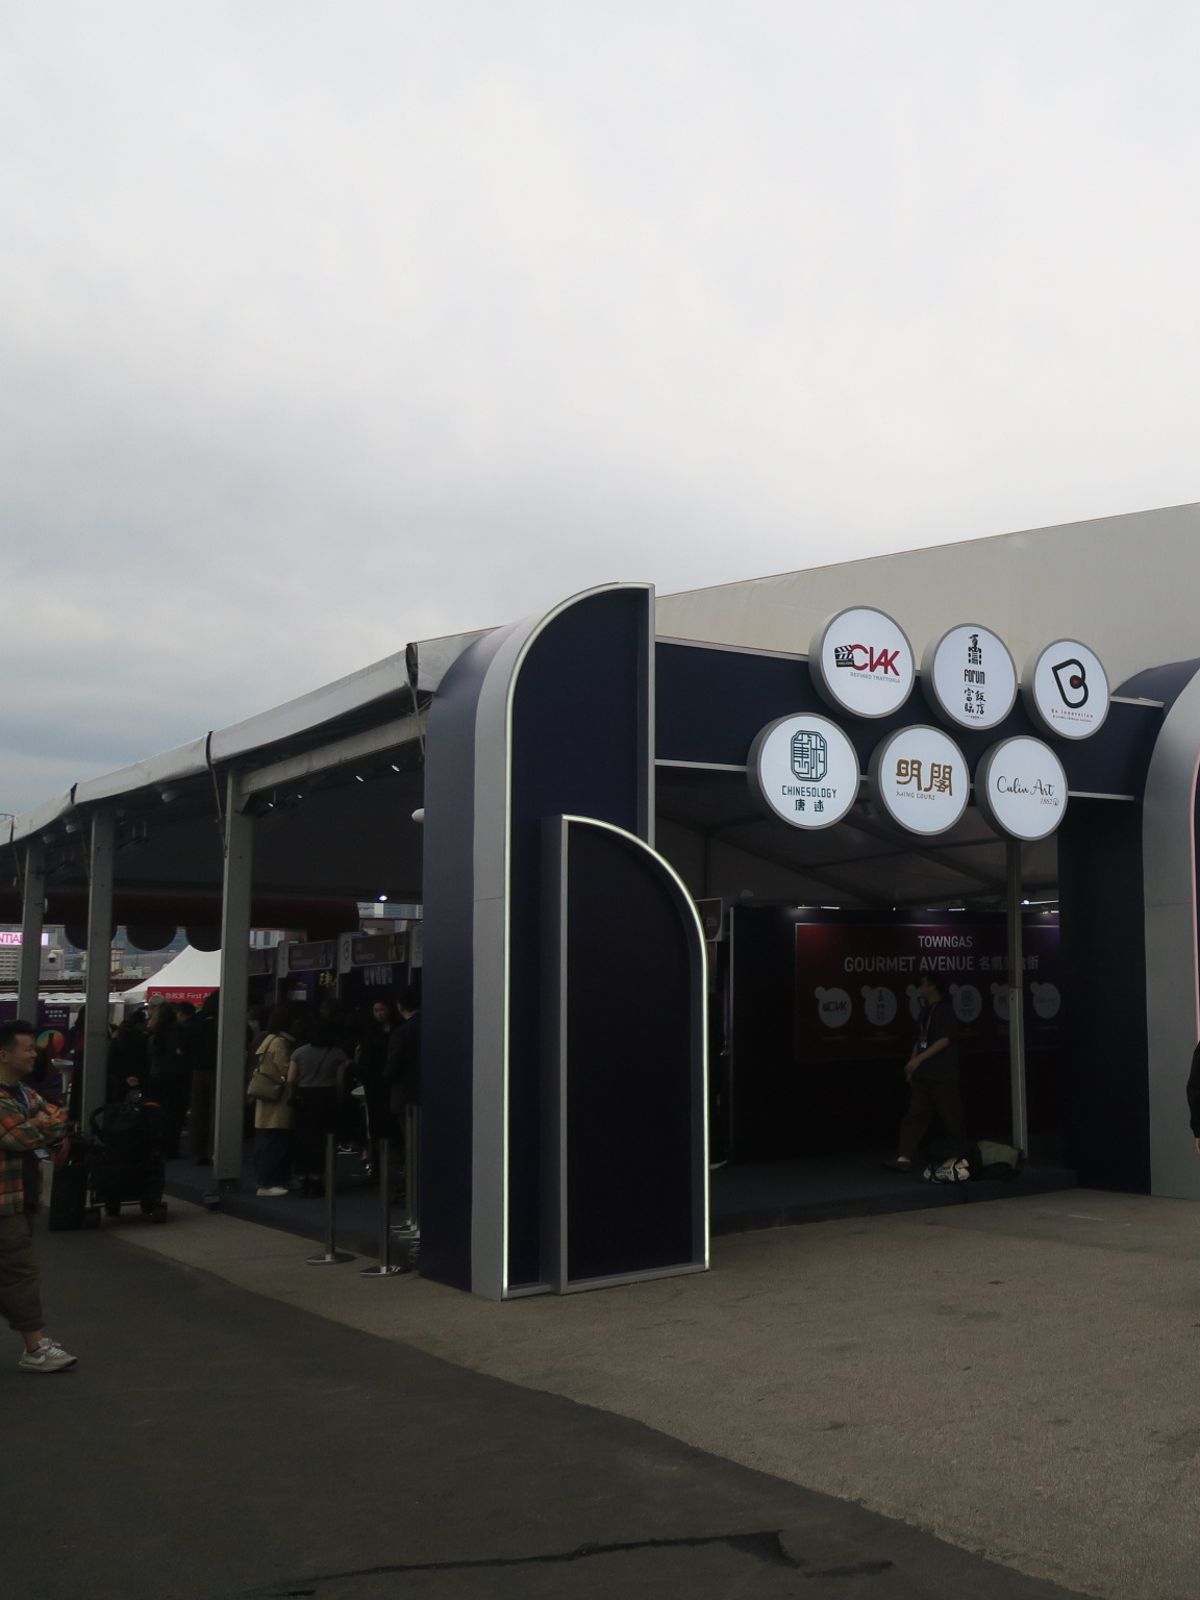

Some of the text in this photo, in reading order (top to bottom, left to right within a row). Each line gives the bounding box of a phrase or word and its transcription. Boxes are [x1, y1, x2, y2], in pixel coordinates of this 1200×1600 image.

[896, 759, 953, 796] 明閣
[782, 785, 837, 798] CHINESOLOGY
[918, 935, 973, 949] TOWNGAS
[844, 956, 915, 973] GOURMET
[919, 955, 974, 972] AVENUE
